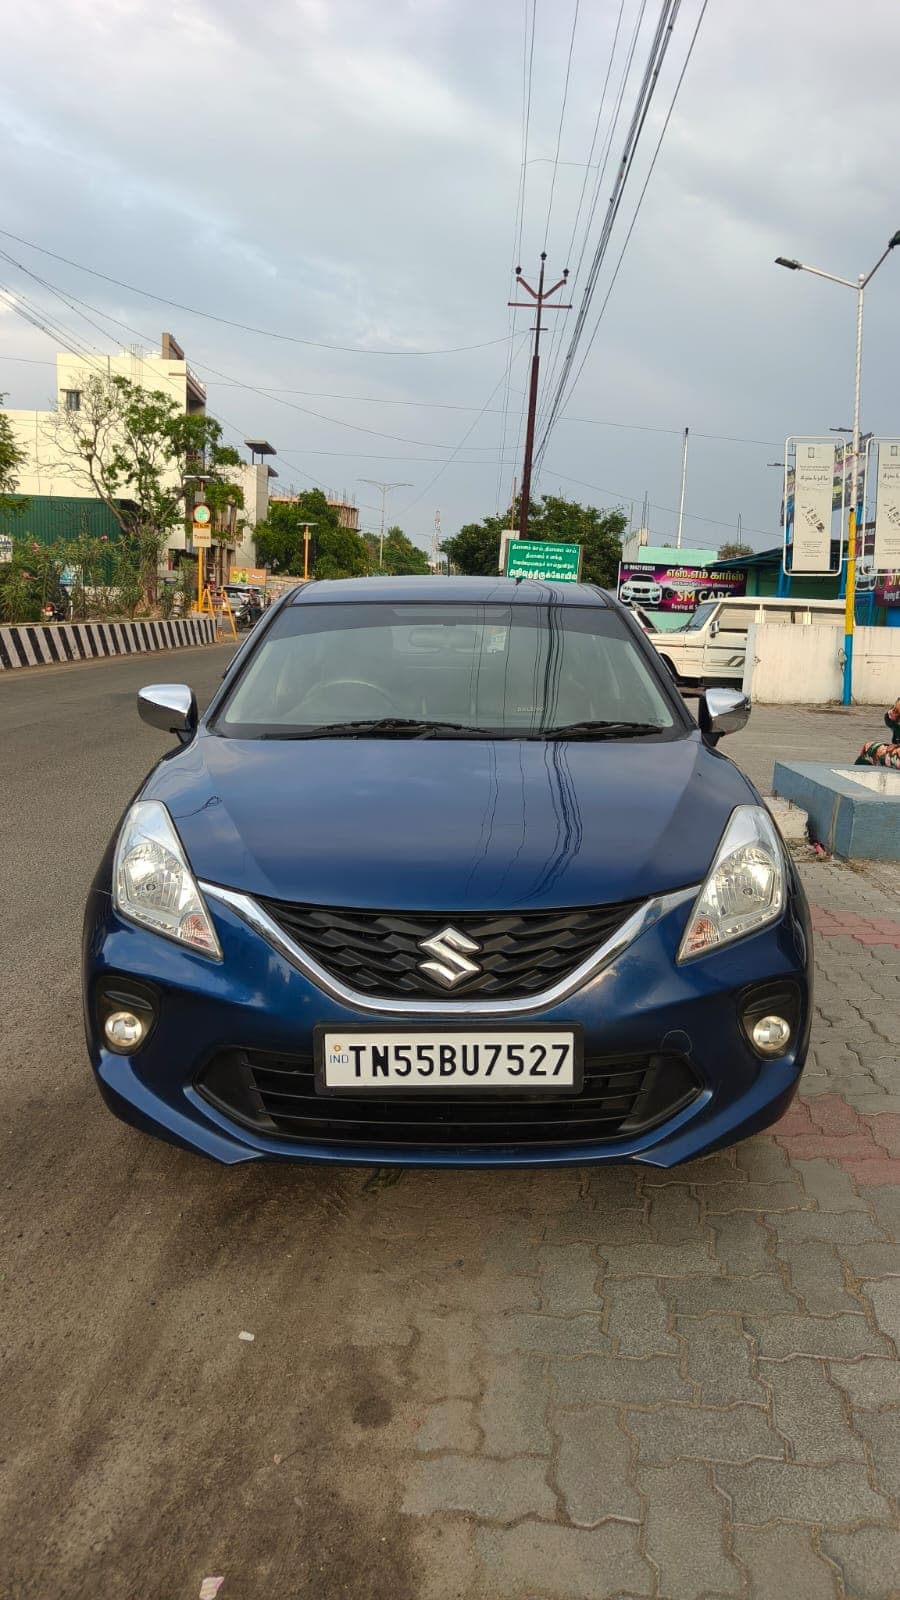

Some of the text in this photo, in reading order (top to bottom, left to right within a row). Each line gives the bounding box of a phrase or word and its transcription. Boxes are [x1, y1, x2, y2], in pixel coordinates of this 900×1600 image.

[677, 591, 695, 602] SM
[329, 1055, 349, 1064] IND
[349, 1045, 570, 1077] TN55BU7527
